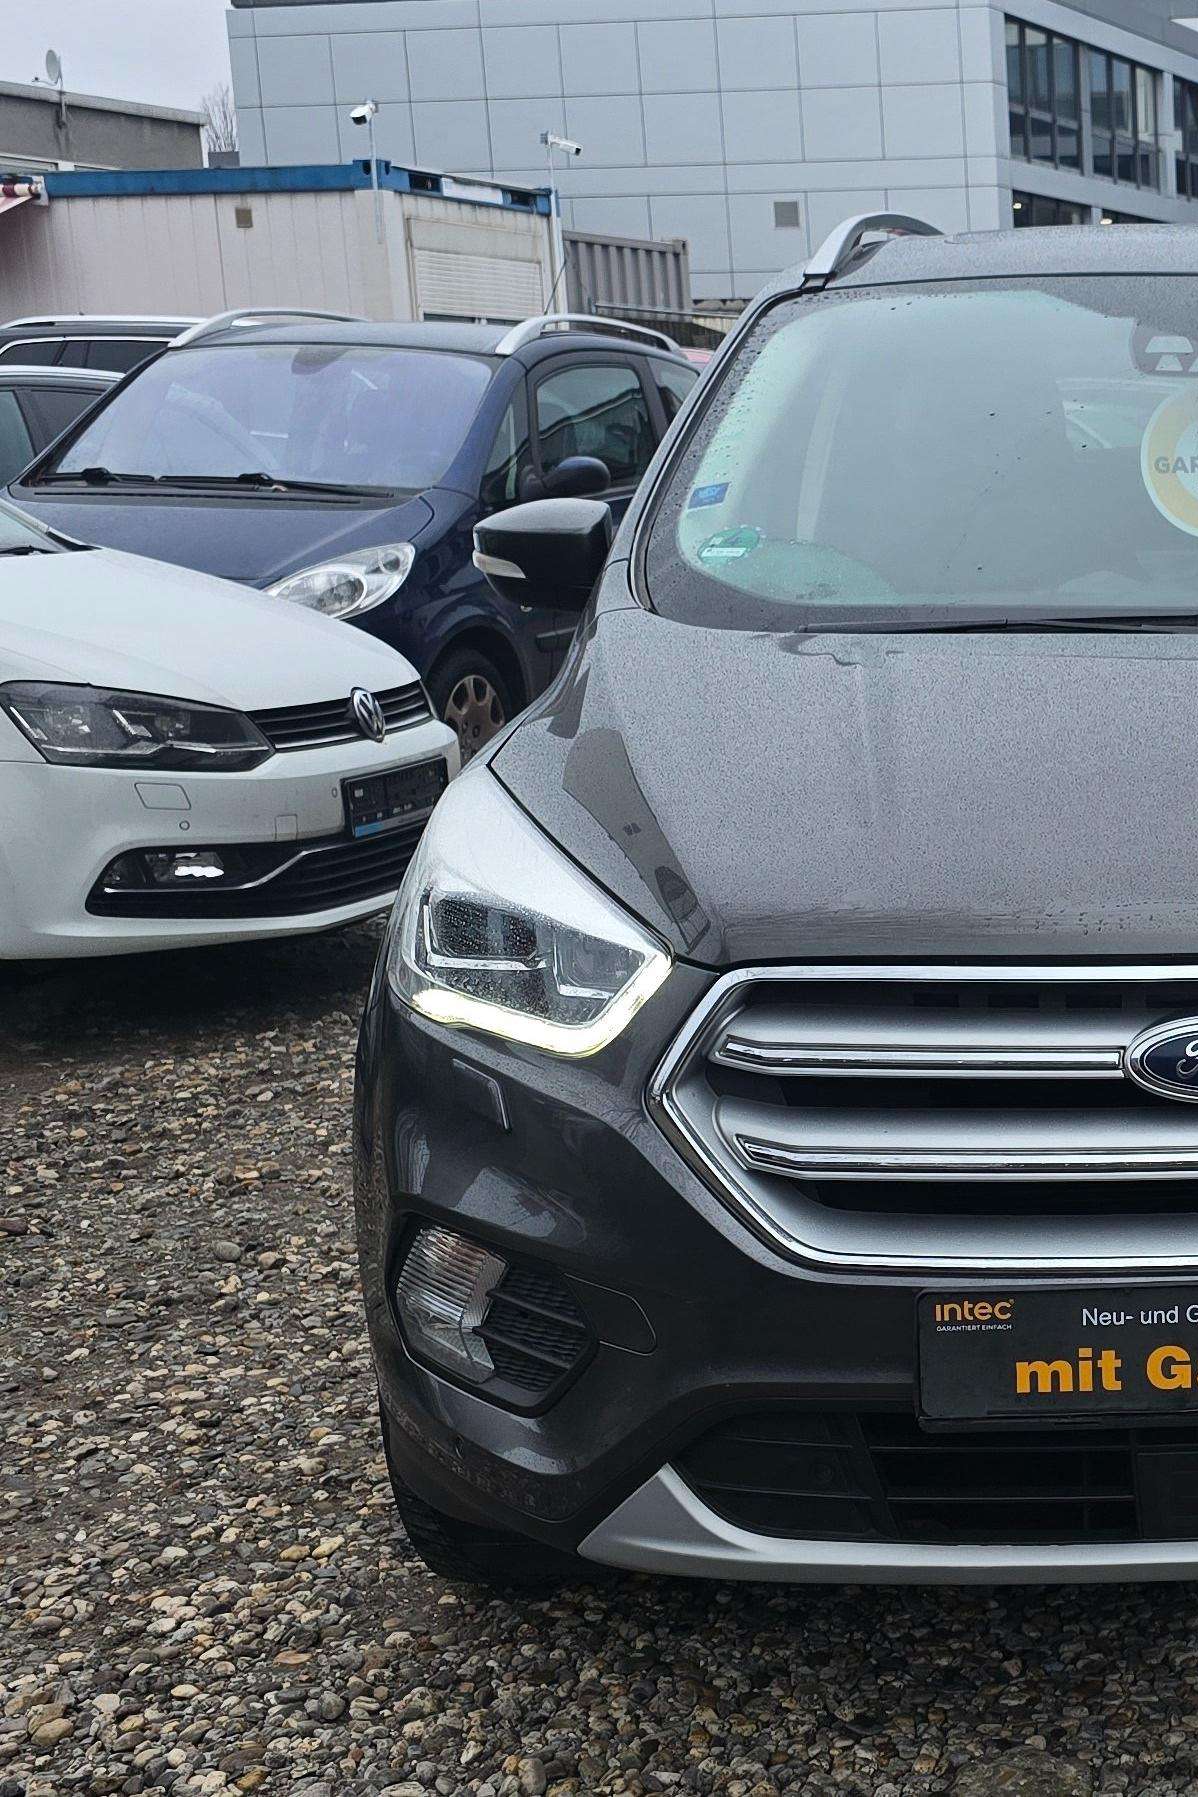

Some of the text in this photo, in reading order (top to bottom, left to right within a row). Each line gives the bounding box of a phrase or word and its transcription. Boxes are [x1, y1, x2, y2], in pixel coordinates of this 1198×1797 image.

[935, 1300, 1012, 1321] intec
[1082, 1308, 1134, 1326] Neu-
[1140, 1306, 1179, 1324] und
[936, 1323, 1012, 1332] GARANTIERT EINFACH
[1016, 1347, 1122, 1393] mit
